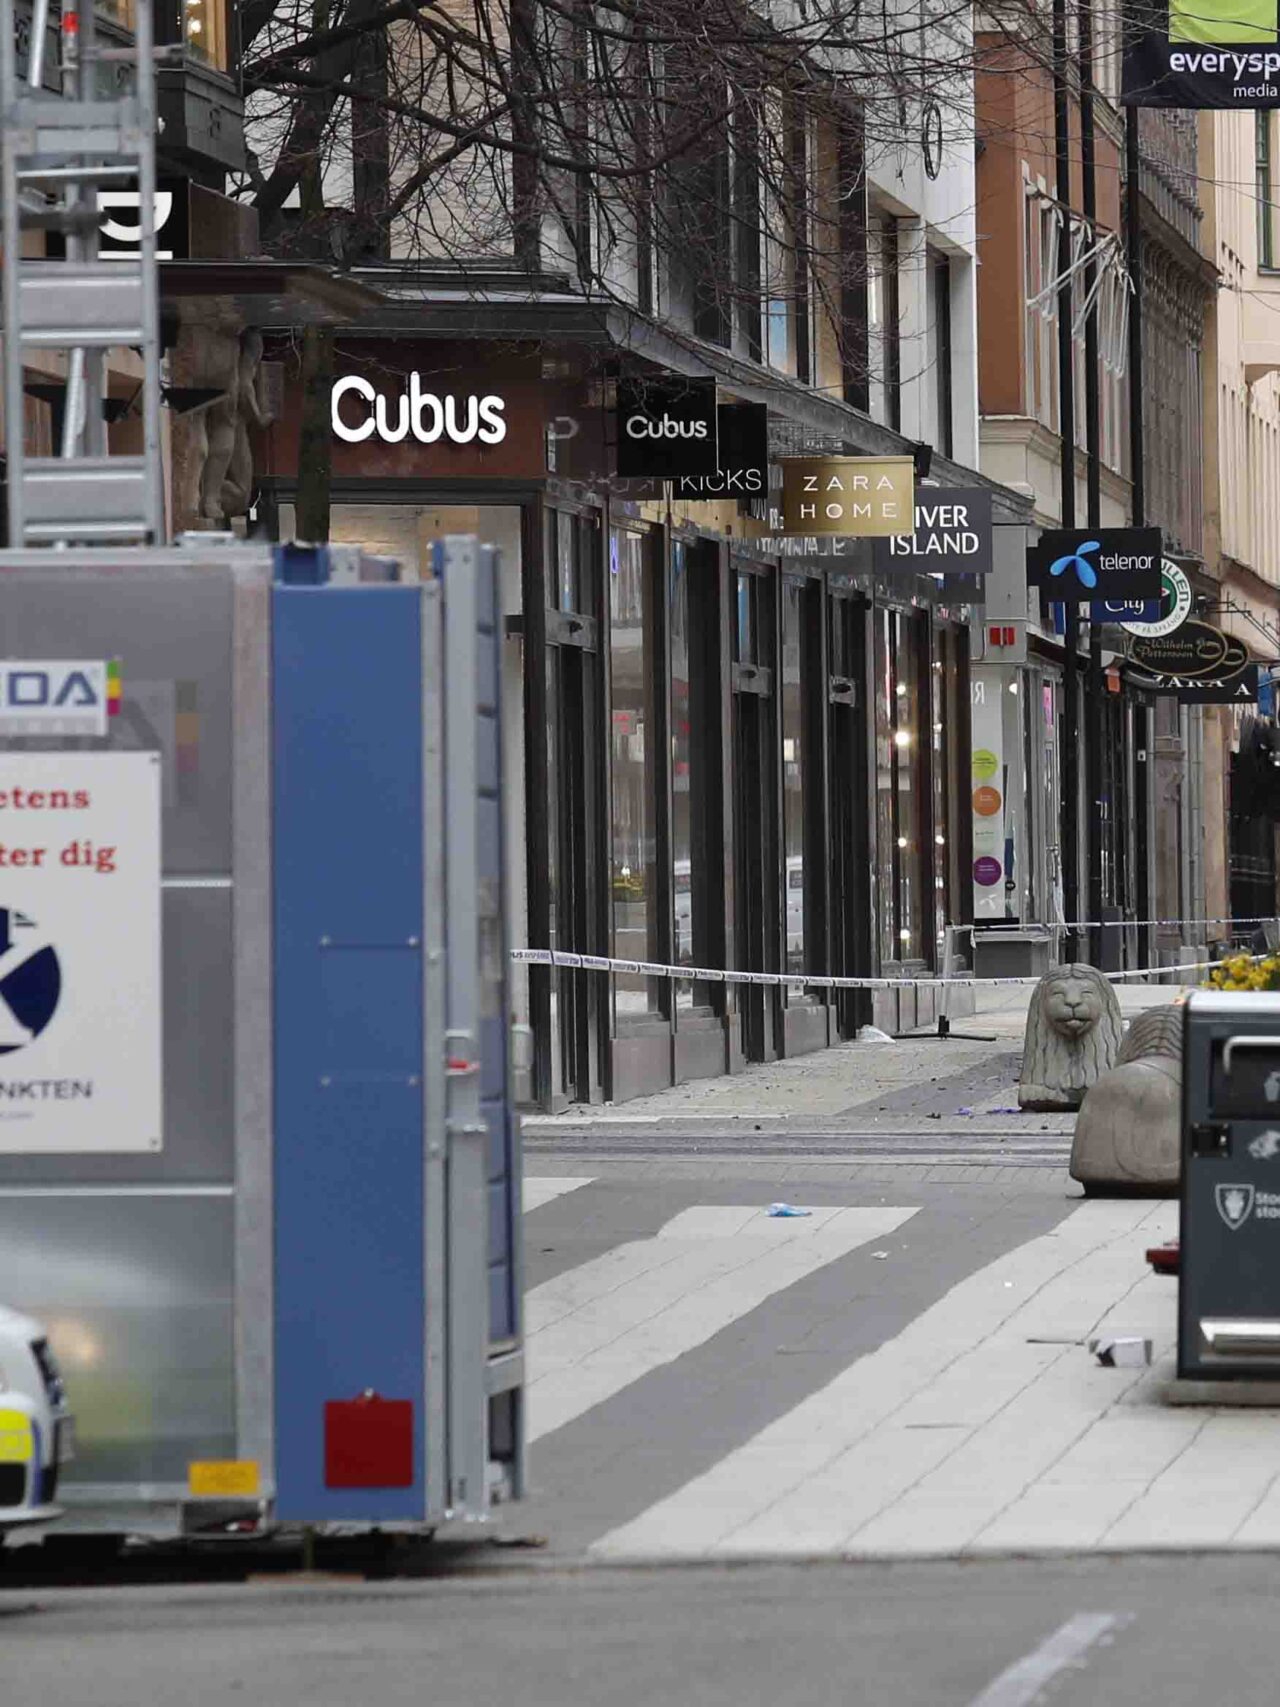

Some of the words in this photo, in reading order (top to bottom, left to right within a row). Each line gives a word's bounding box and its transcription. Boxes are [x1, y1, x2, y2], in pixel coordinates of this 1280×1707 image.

[1233, 84, 1278, 97] media
[331, 372, 507, 445] Cubus
[626, 413, 708, 439] Cubus
[803, 476, 894, 492] ZARA
[801, 503, 898, 519] HOME
[914, 505, 969, 528] IVER
[889, 532, 979, 556] ISLAND
[1100, 554, 1155, 571] telenor
[60, 839, 117, 874] dig
